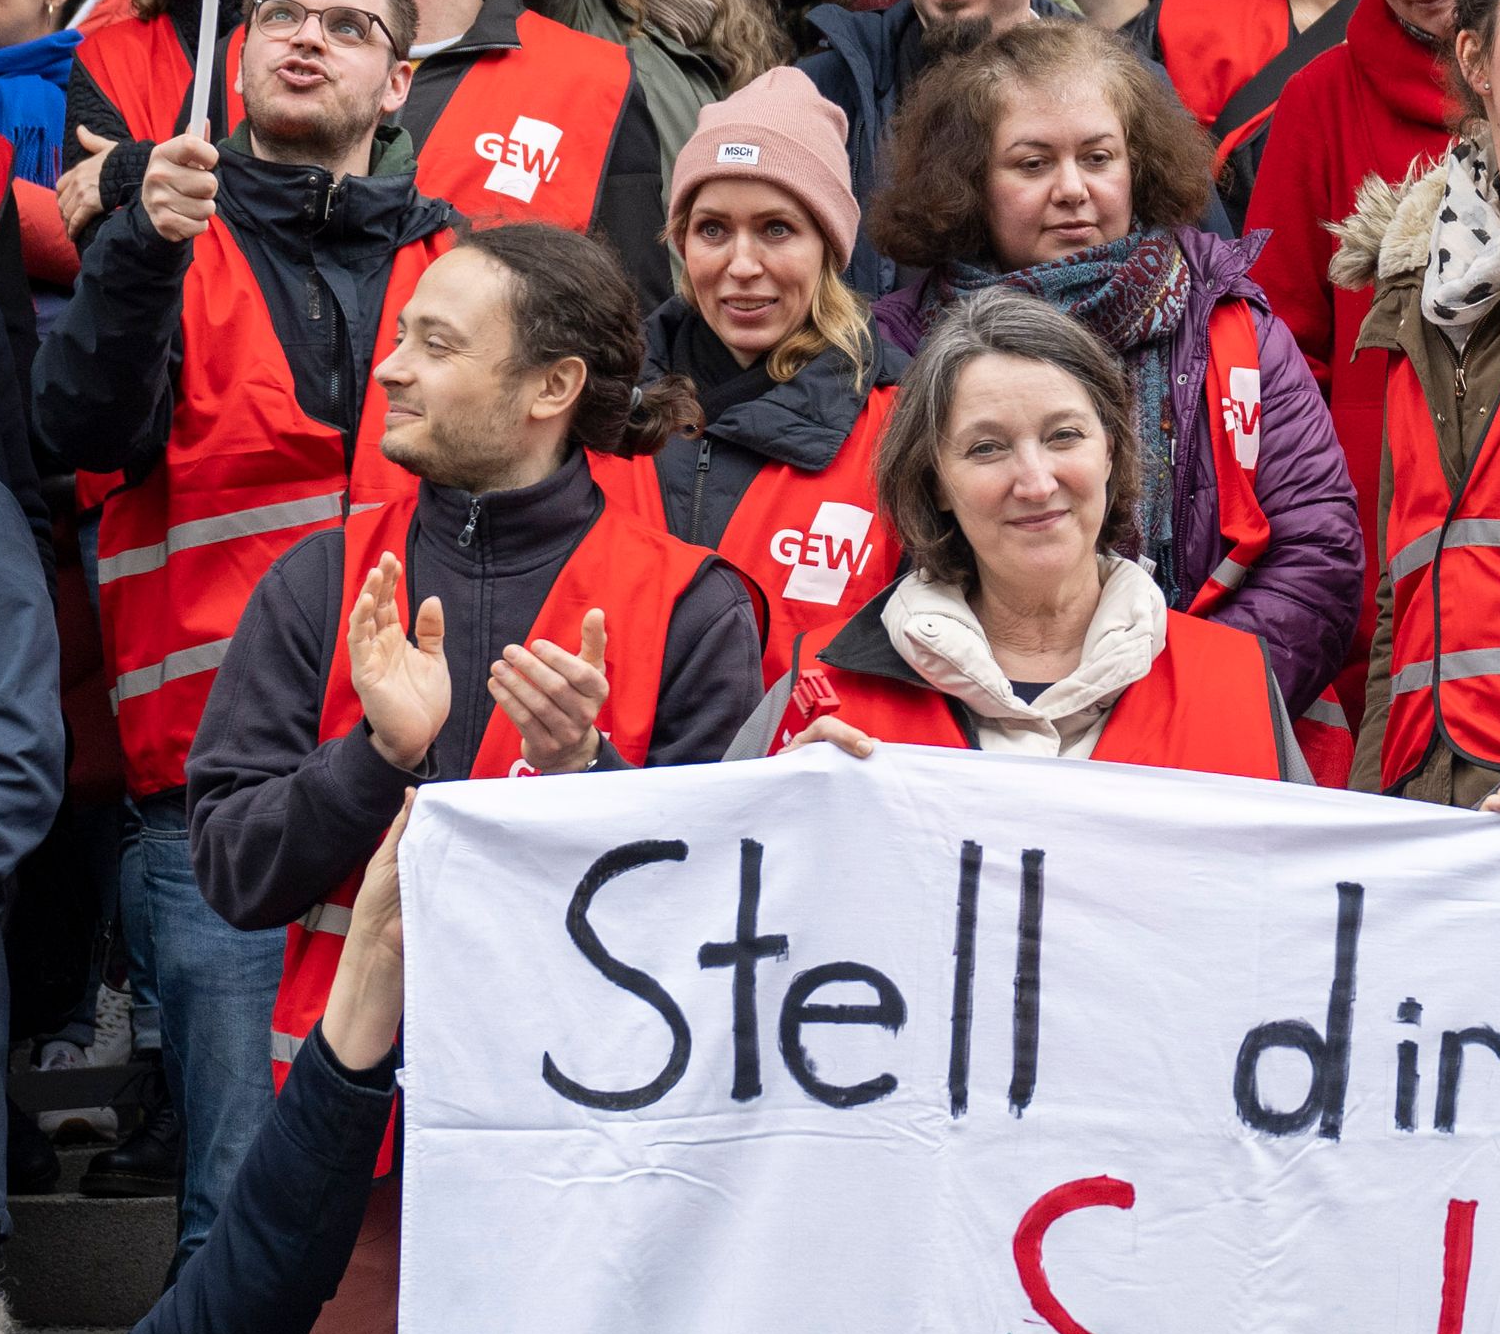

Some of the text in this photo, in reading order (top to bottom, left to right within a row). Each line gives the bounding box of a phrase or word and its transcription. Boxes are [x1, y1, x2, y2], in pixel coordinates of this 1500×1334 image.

[474, 132, 560, 183] GEW
[724, 146, 754, 157] MSCH
[769, 528, 874, 576] GEW
[539, 836, 1047, 1120] Stell
